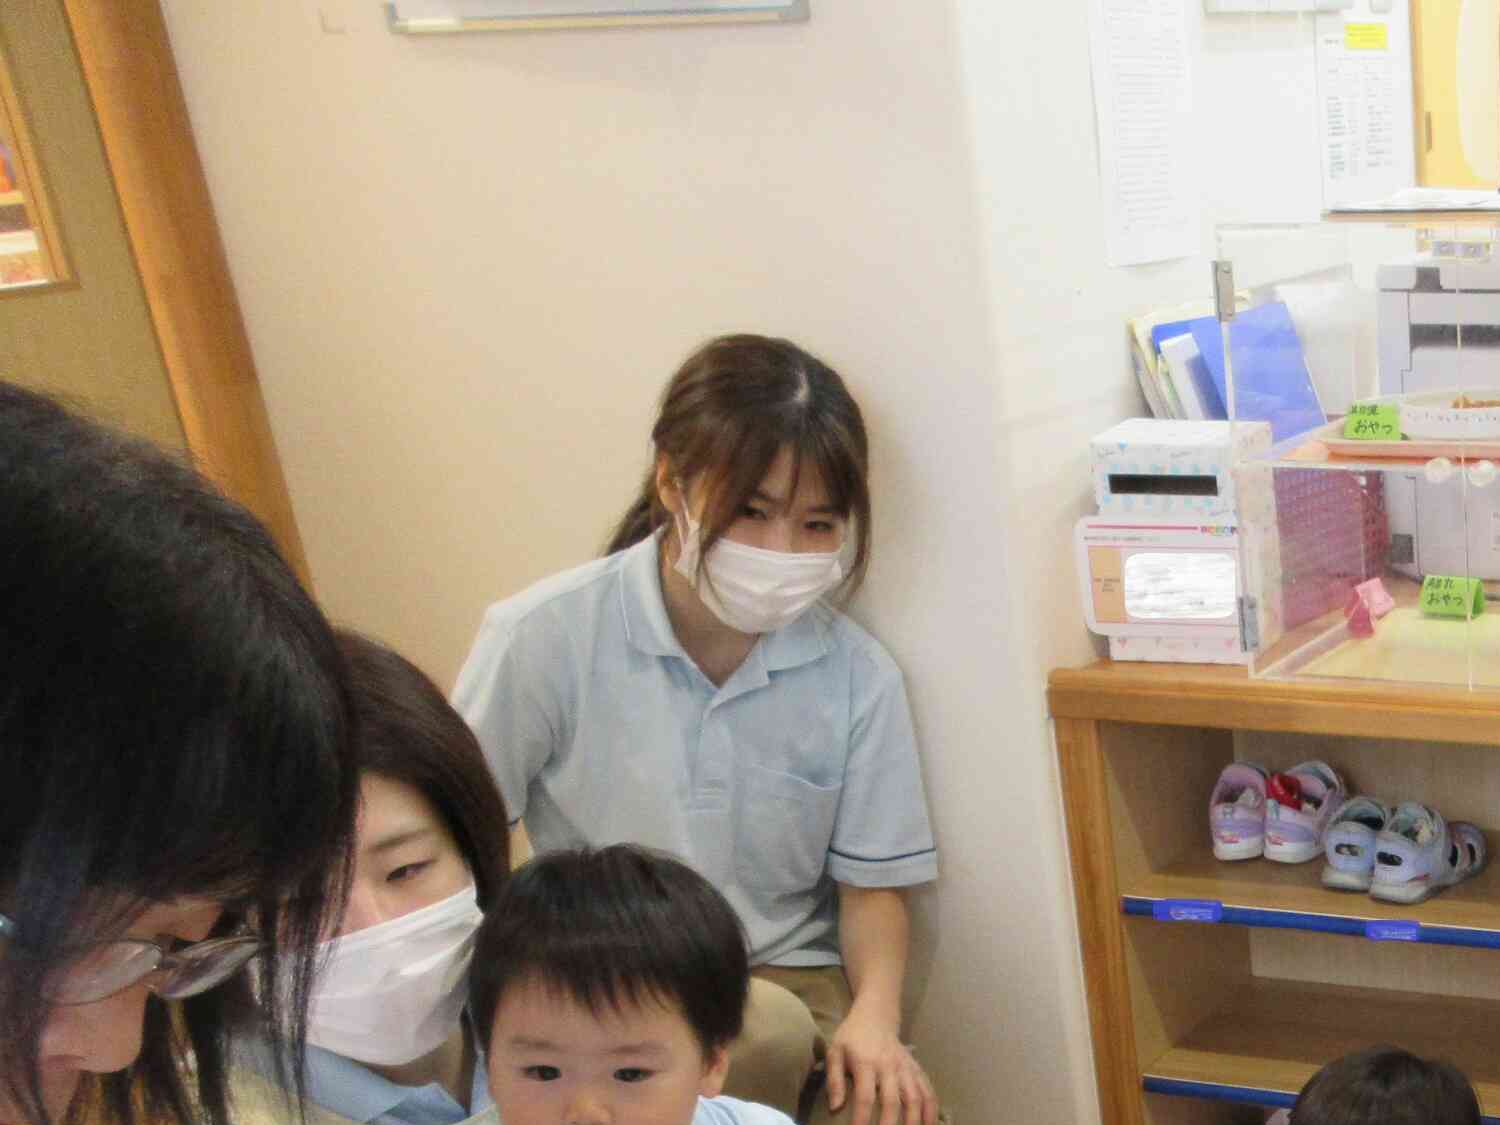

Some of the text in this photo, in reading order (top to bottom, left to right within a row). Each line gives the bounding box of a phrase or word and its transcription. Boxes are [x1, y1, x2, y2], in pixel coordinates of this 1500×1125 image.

[1354, 419, 1393, 435] おやつ
[1427, 592, 1464, 607] おやつ
